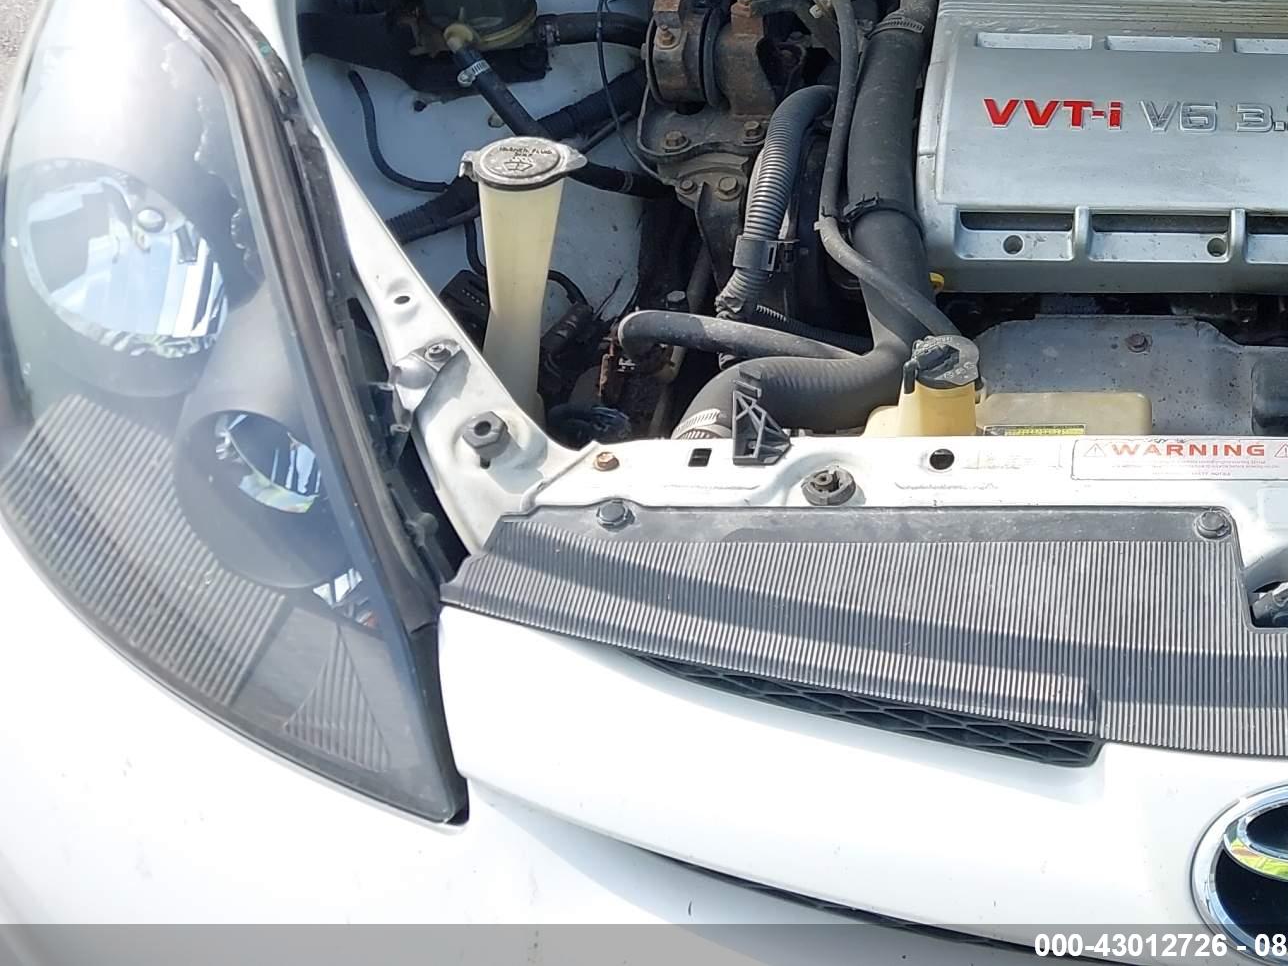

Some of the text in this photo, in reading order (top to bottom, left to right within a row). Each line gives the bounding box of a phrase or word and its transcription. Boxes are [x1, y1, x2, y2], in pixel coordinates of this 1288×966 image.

[984, 98, 1122, 130] VVT-i
[1139, 100, 1219, 132] V6
[1112, 443, 1265, 457] WARNING
